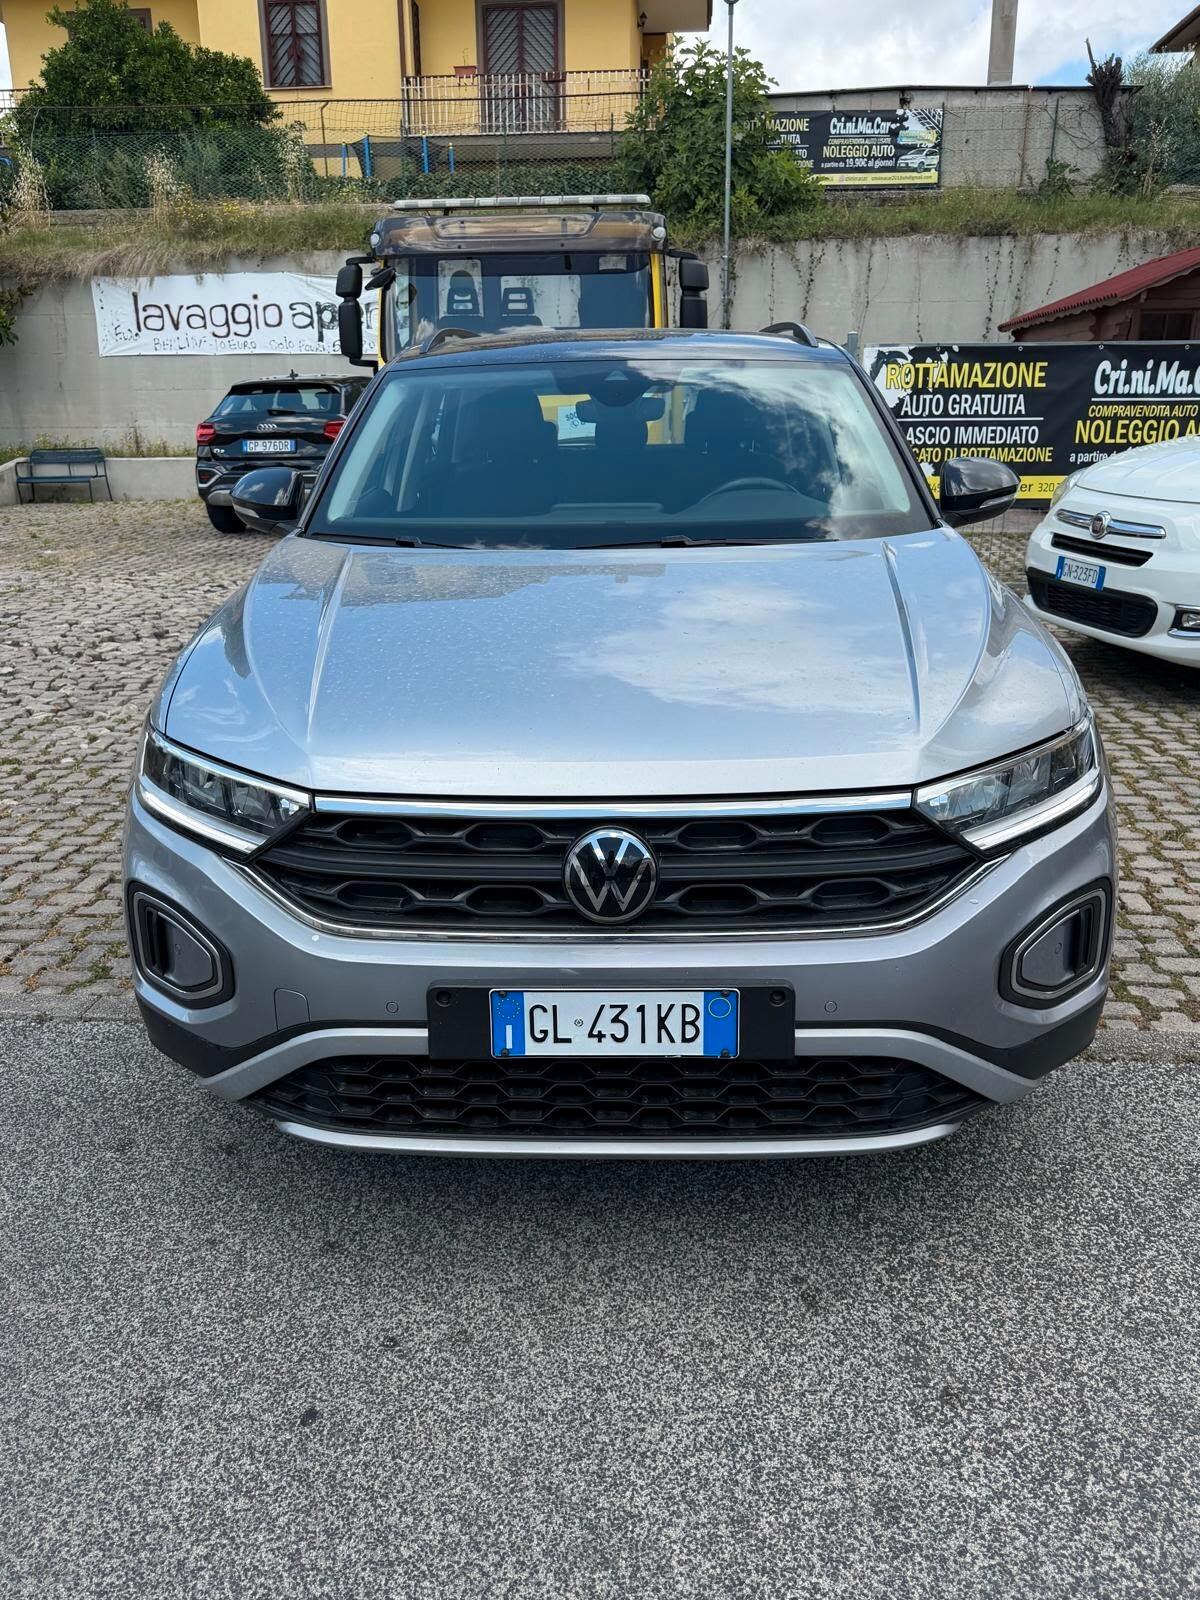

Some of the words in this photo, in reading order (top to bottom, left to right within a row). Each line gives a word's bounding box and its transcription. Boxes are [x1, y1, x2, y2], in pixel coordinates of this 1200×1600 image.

[830, 117, 891, 134] Cri.ni.Ma.Car
[823, 145, 869, 158] NOLEGGIO
[871, 144, 895, 157] AUTO
[868, 159, 874, 167] al
[874, 158, 896, 169] giorno!
[132, 292, 283, 339] lavaggio
[886, 361, 1048, 389] ROTTAMAZIONE
[901, 395, 944, 416] AUTO
[949, 394, 1026, 415] GRATUITA
[1088, 405, 1170, 418] COMPRAVENDITA
[1171, 404, 1199, 417] AUTO
[906, 426, 950, 445] ASCIO
[954, 426, 1038, 445] IMMEDIATO
[1074, 419, 1180, 444] NOLEGGIO
[249, 441, 260, 451] GP
[262, 441, 289, 451] 976DR
[944, 447, 957, 461] DI
[960, 446, 1053, 463] ROTTAMAZIONE
[1069, 453, 1076, 463] a
[1077, 451, 1108, 465] partire
[1074, 565, 1098, 584] 323FD
[529, 1003, 572, 1044] GL
[588, 1003, 701, 1044] 431KB
